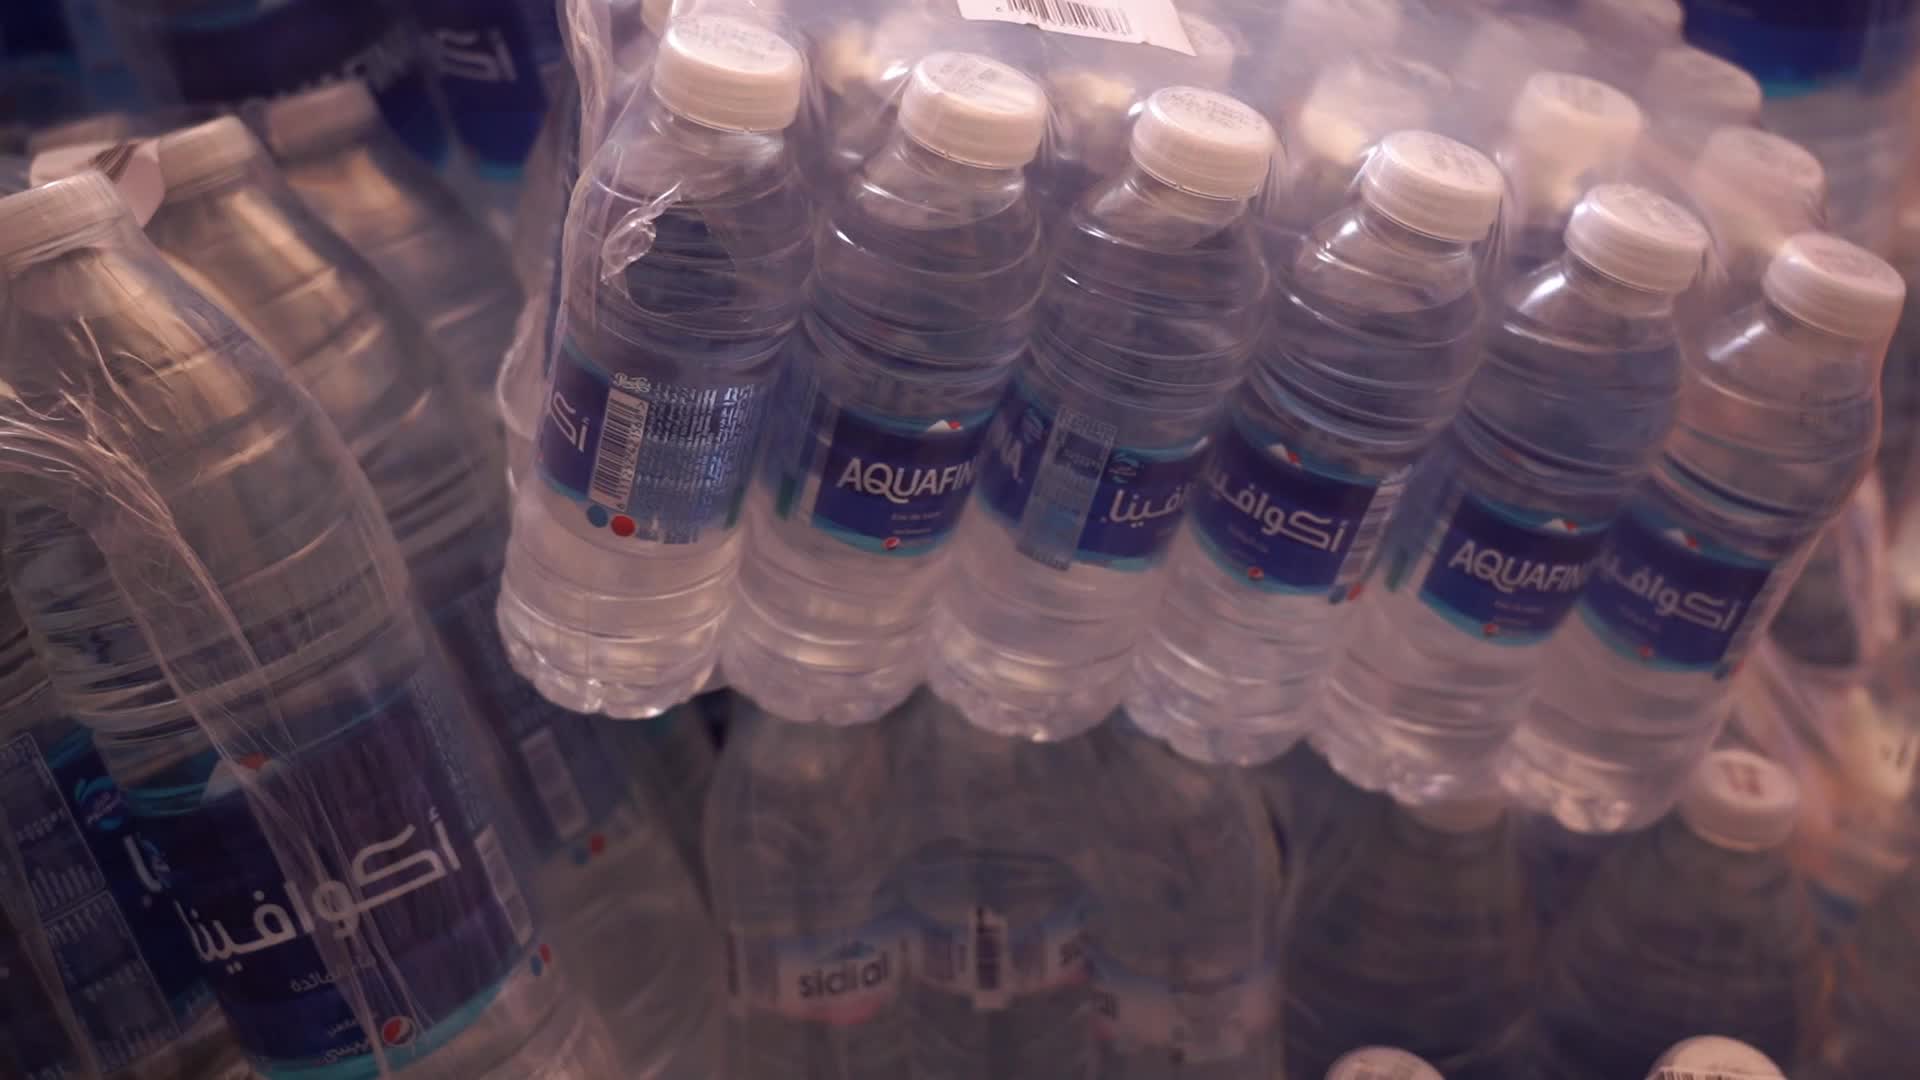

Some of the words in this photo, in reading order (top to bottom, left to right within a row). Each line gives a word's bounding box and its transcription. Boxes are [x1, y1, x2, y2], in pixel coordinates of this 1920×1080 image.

[836, 456, 977, 504] AQUAFIN
[1448, 540, 1580, 594] AQUAFIN
[175, 806, 461, 974] أكوافينا
